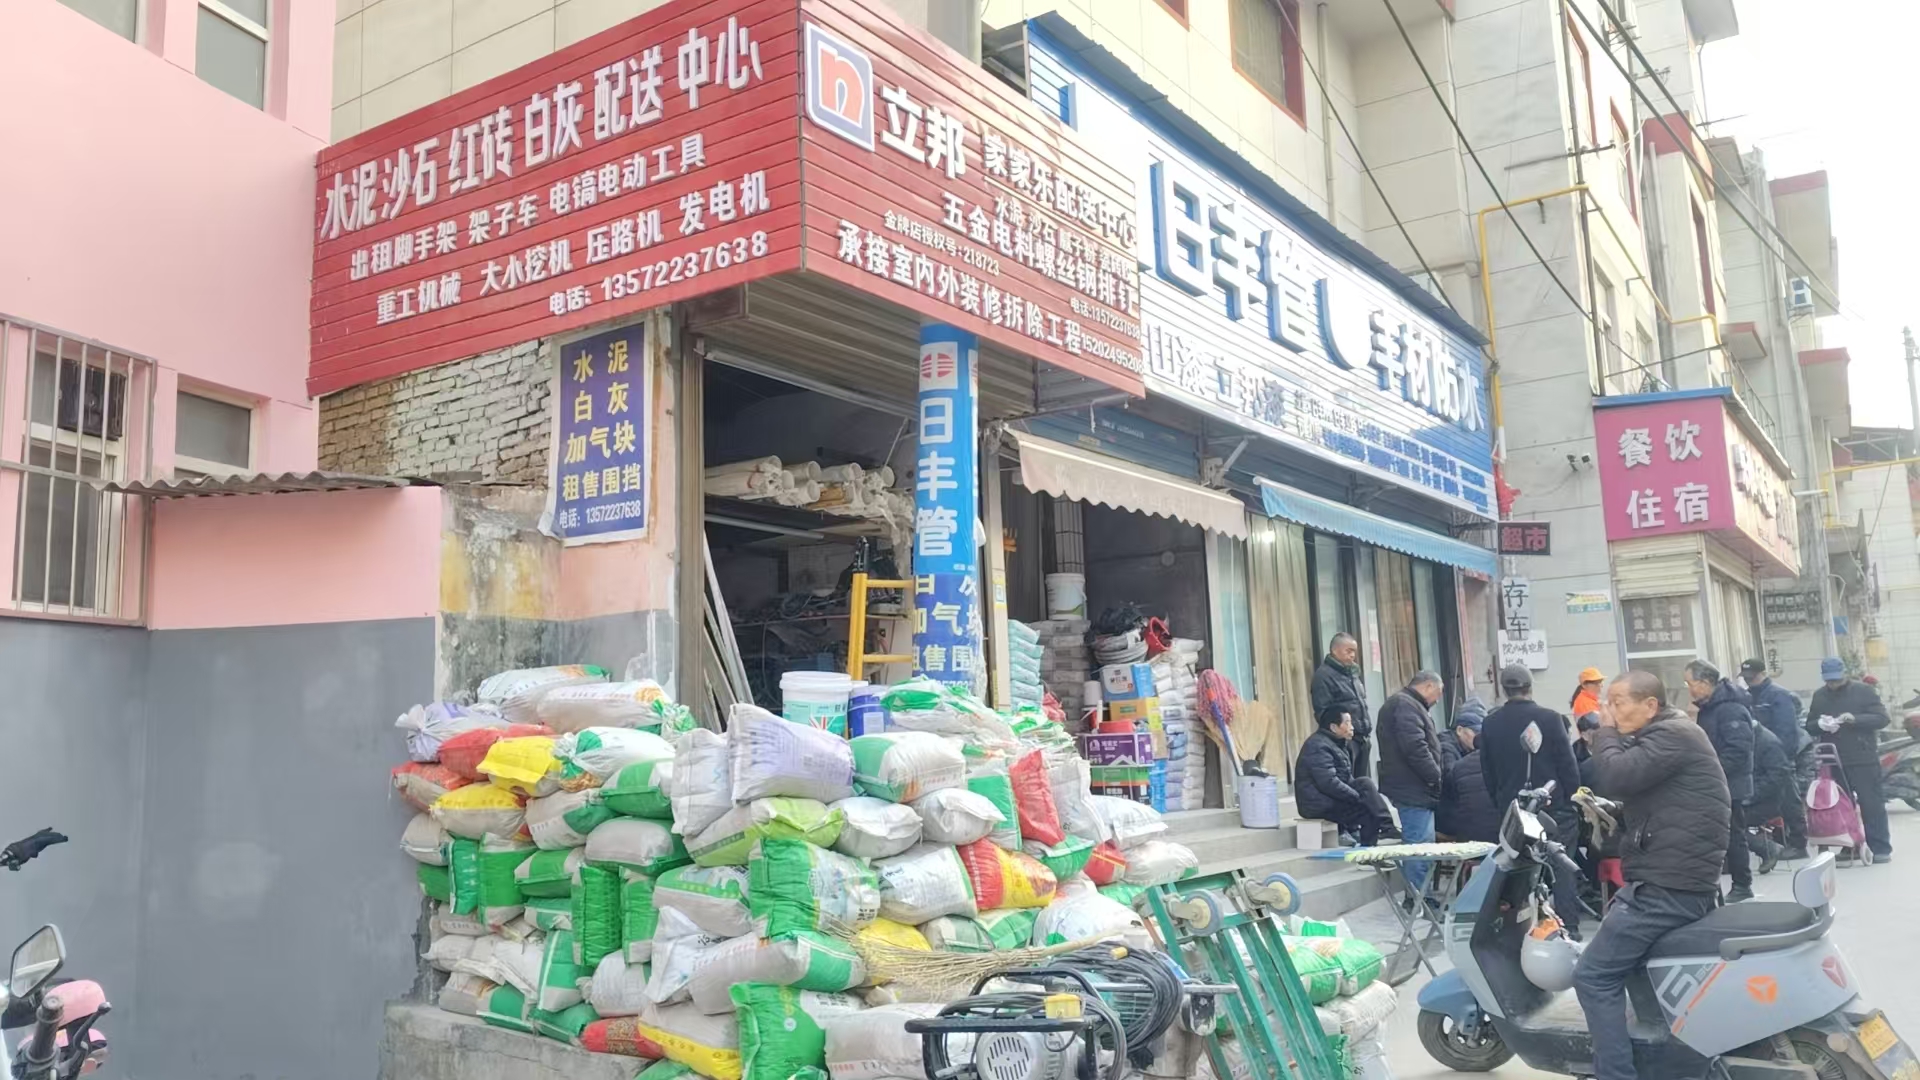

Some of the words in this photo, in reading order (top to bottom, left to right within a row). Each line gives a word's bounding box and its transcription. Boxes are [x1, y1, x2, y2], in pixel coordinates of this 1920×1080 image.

[320, 137, 440, 240] 水泥沙石
[448, 106, 514, 194] 红砖
[524, 80, 584, 168] 白灰
[594, 44, 664, 141] 配送
[677, 15, 764, 110] 中心
[879, 86, 967, 180] 立邦
[981, 131, 1138, 250] 家家乐配送中心
[349, 221, 458, 281] 出租脚手架
[468, 194, 540, 246] 架子车
[376, 272, 462, 325] 重工机械
[480, 239, 573, 297] 大小挖机
[586, 208, 665, 266] 压路机
[678, 170, 771, 236] 发电机
[600, 230, 769, 301] 13572237638
[836, 218, 1082, 356] 承接室内外装修拆除工程
[572, 339, 629, 384] 水泥
[573, 381, 630, 424] 白灰
[563, 419, 637, 466] 加气块
[1618, 419, 1703, 469] 餐饮
[562, 462, 642, 502] 租售围挡
[915, 397, 959, 557] 日丰管
[1626, 482, 1710, 530] 住宿
[1501, 526, 1548, 551] 超市
[1503, 580, 1529, 640] 存车
